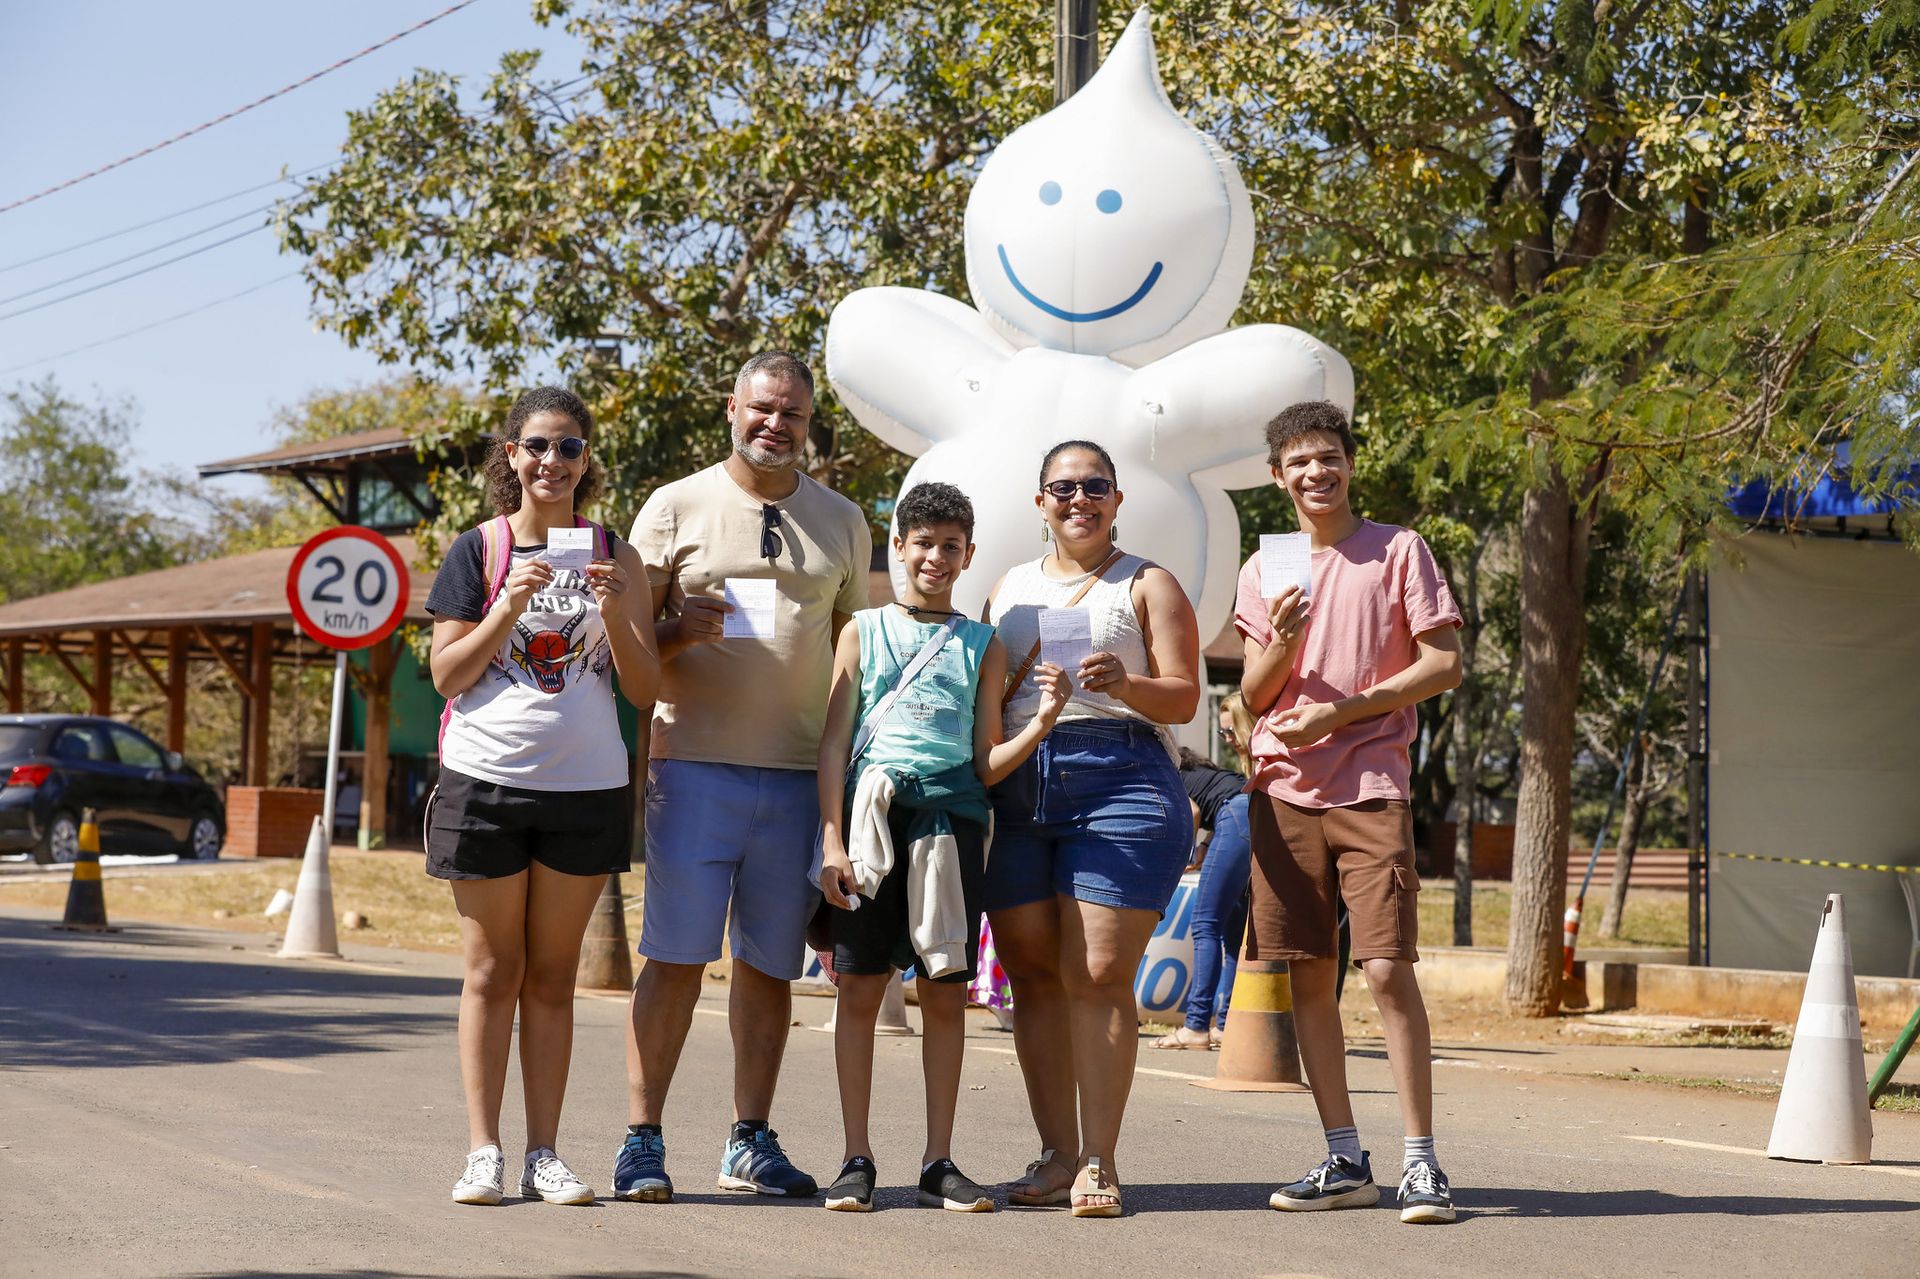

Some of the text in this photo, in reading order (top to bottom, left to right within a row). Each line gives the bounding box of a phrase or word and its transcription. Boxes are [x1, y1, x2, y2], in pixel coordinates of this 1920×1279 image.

[312, 556, 387, 607] 20
[530, 595, 573, 614] LUB
[323, 610, 369, 630] km/h
